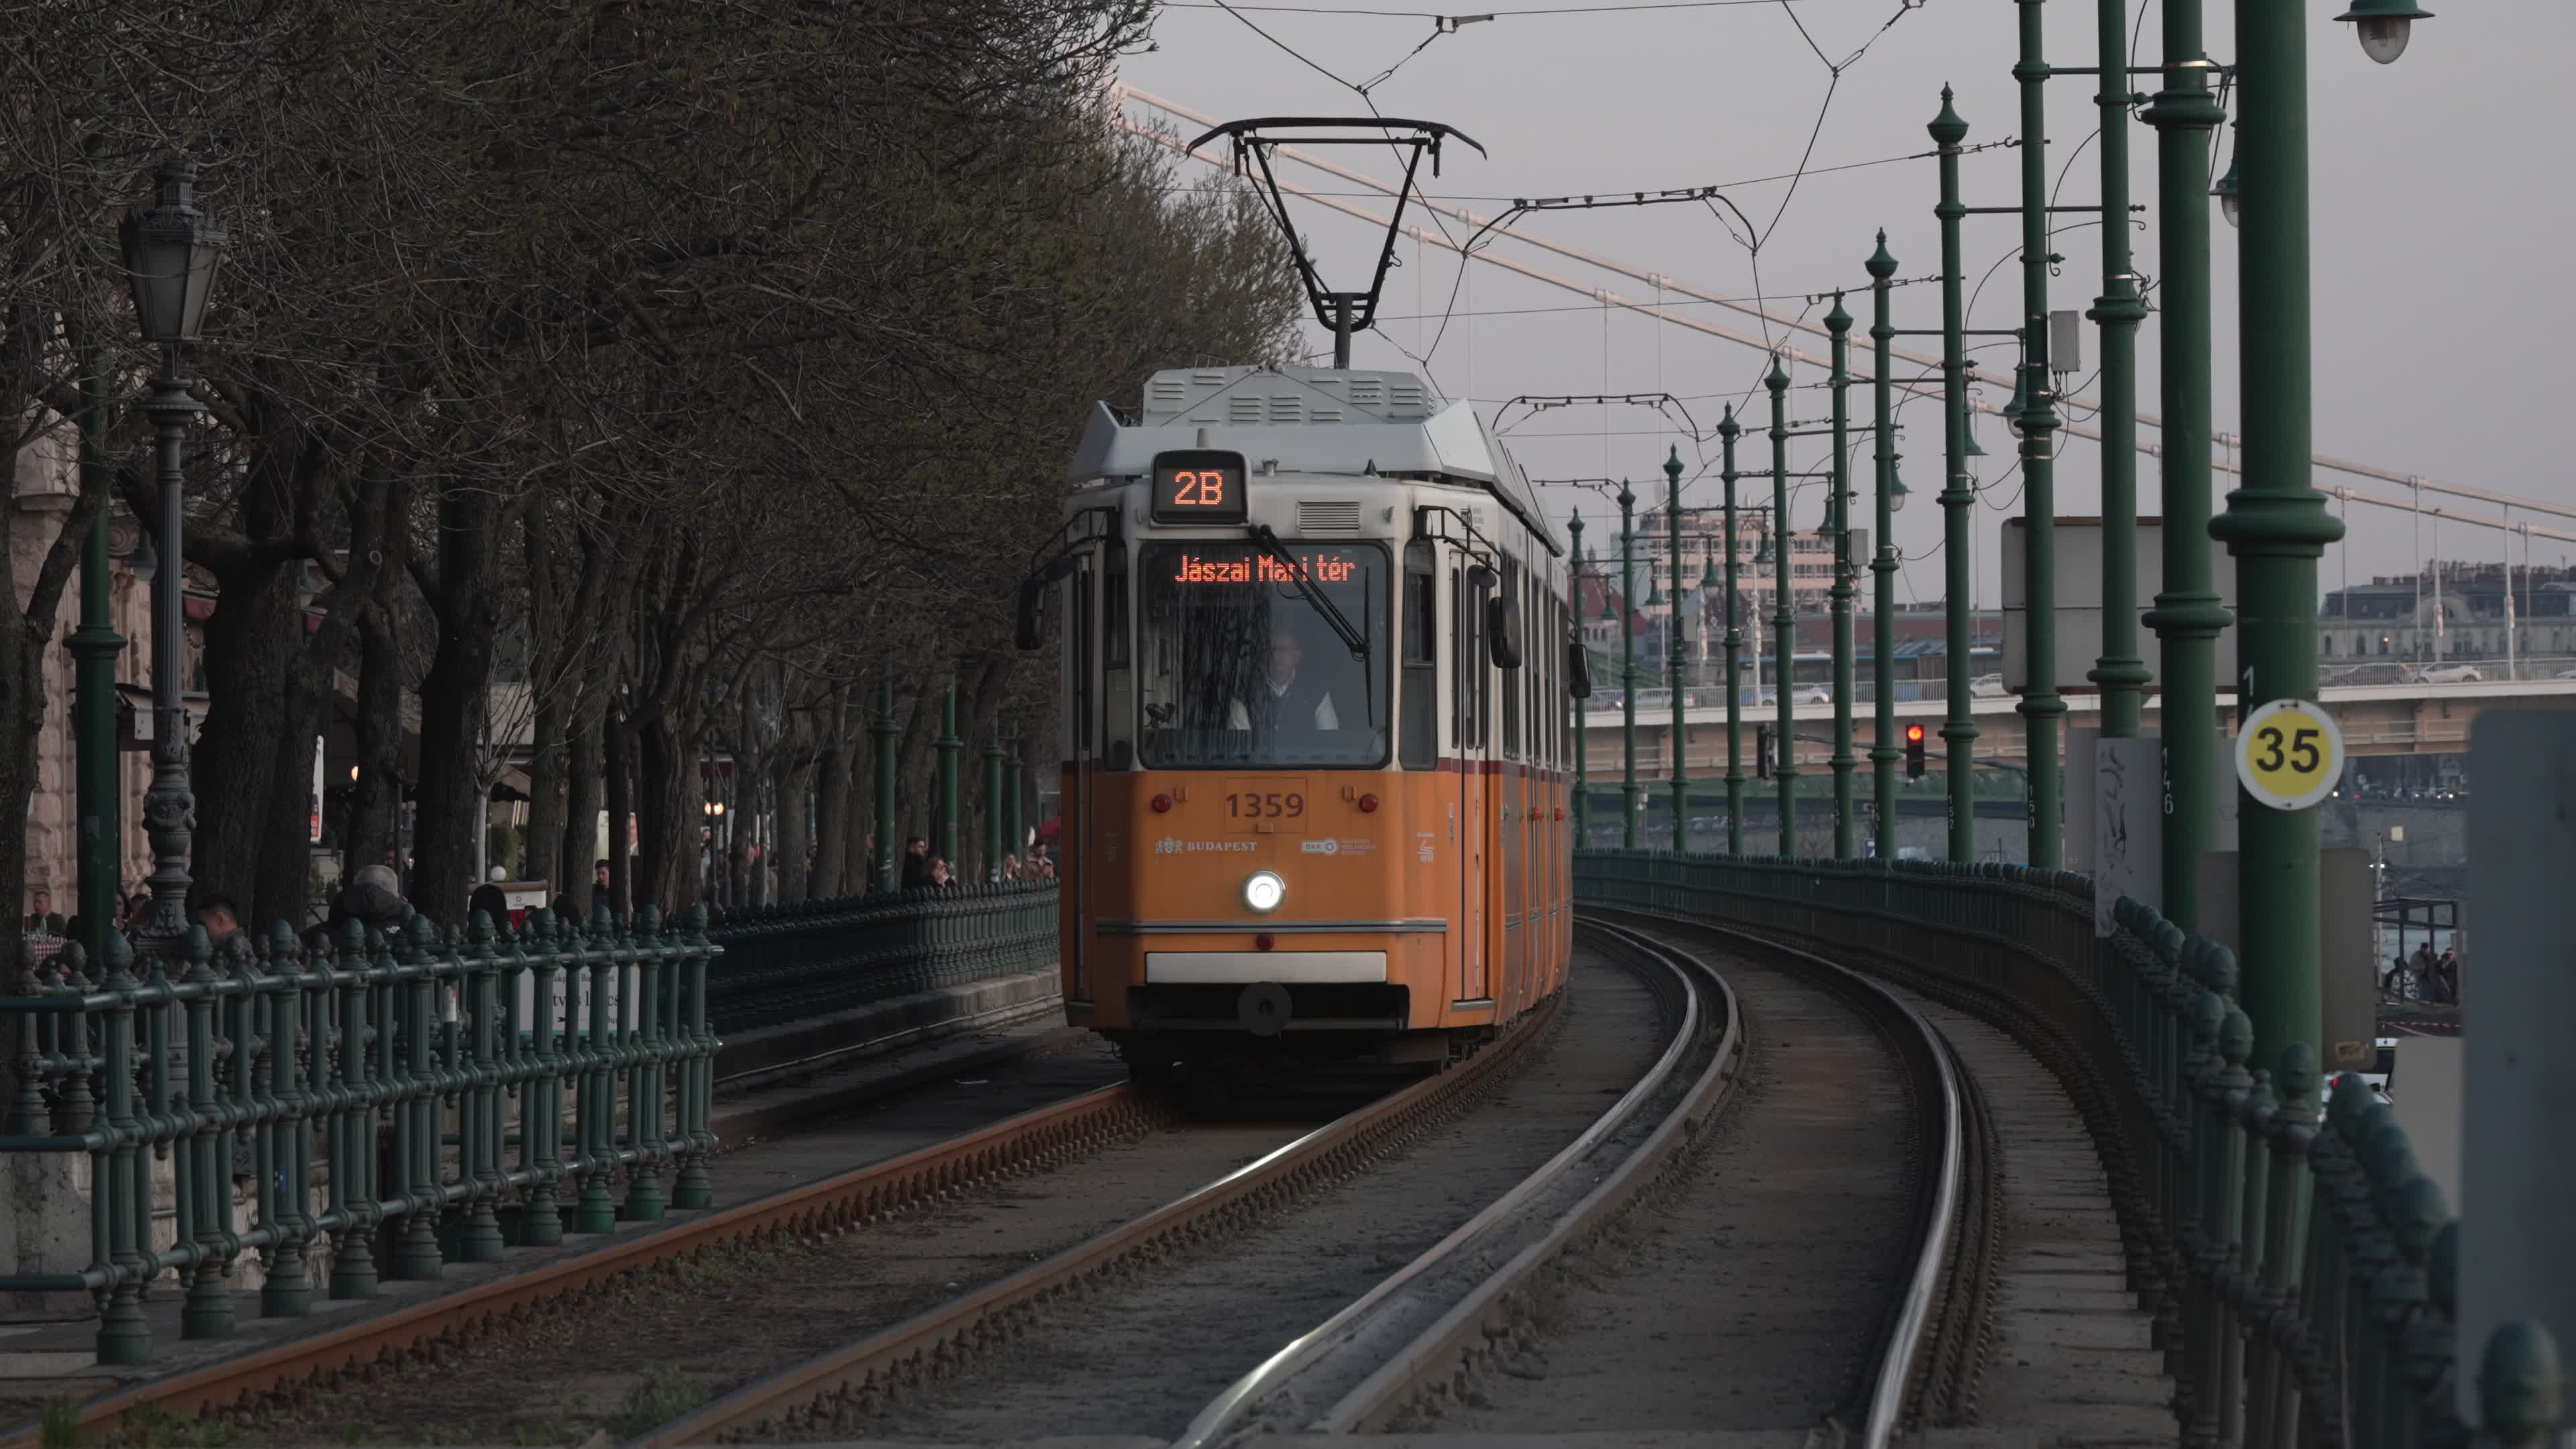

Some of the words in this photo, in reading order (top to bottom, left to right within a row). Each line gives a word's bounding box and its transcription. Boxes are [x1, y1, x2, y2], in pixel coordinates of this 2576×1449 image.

[1175, 472, 1224, 505] 2B
[1175, 554, 1250, 582] Jászai
[1257, 554, 1308, 582] Mari
[1316, 554, 1356, 582] tér
[2256, 727, 2319, 773] 35
[2162, 747, 2174, 814] 146
[1226, 793, 1304, 818] 1359
[1187, 841, 1257, 852] BUDAPEST
